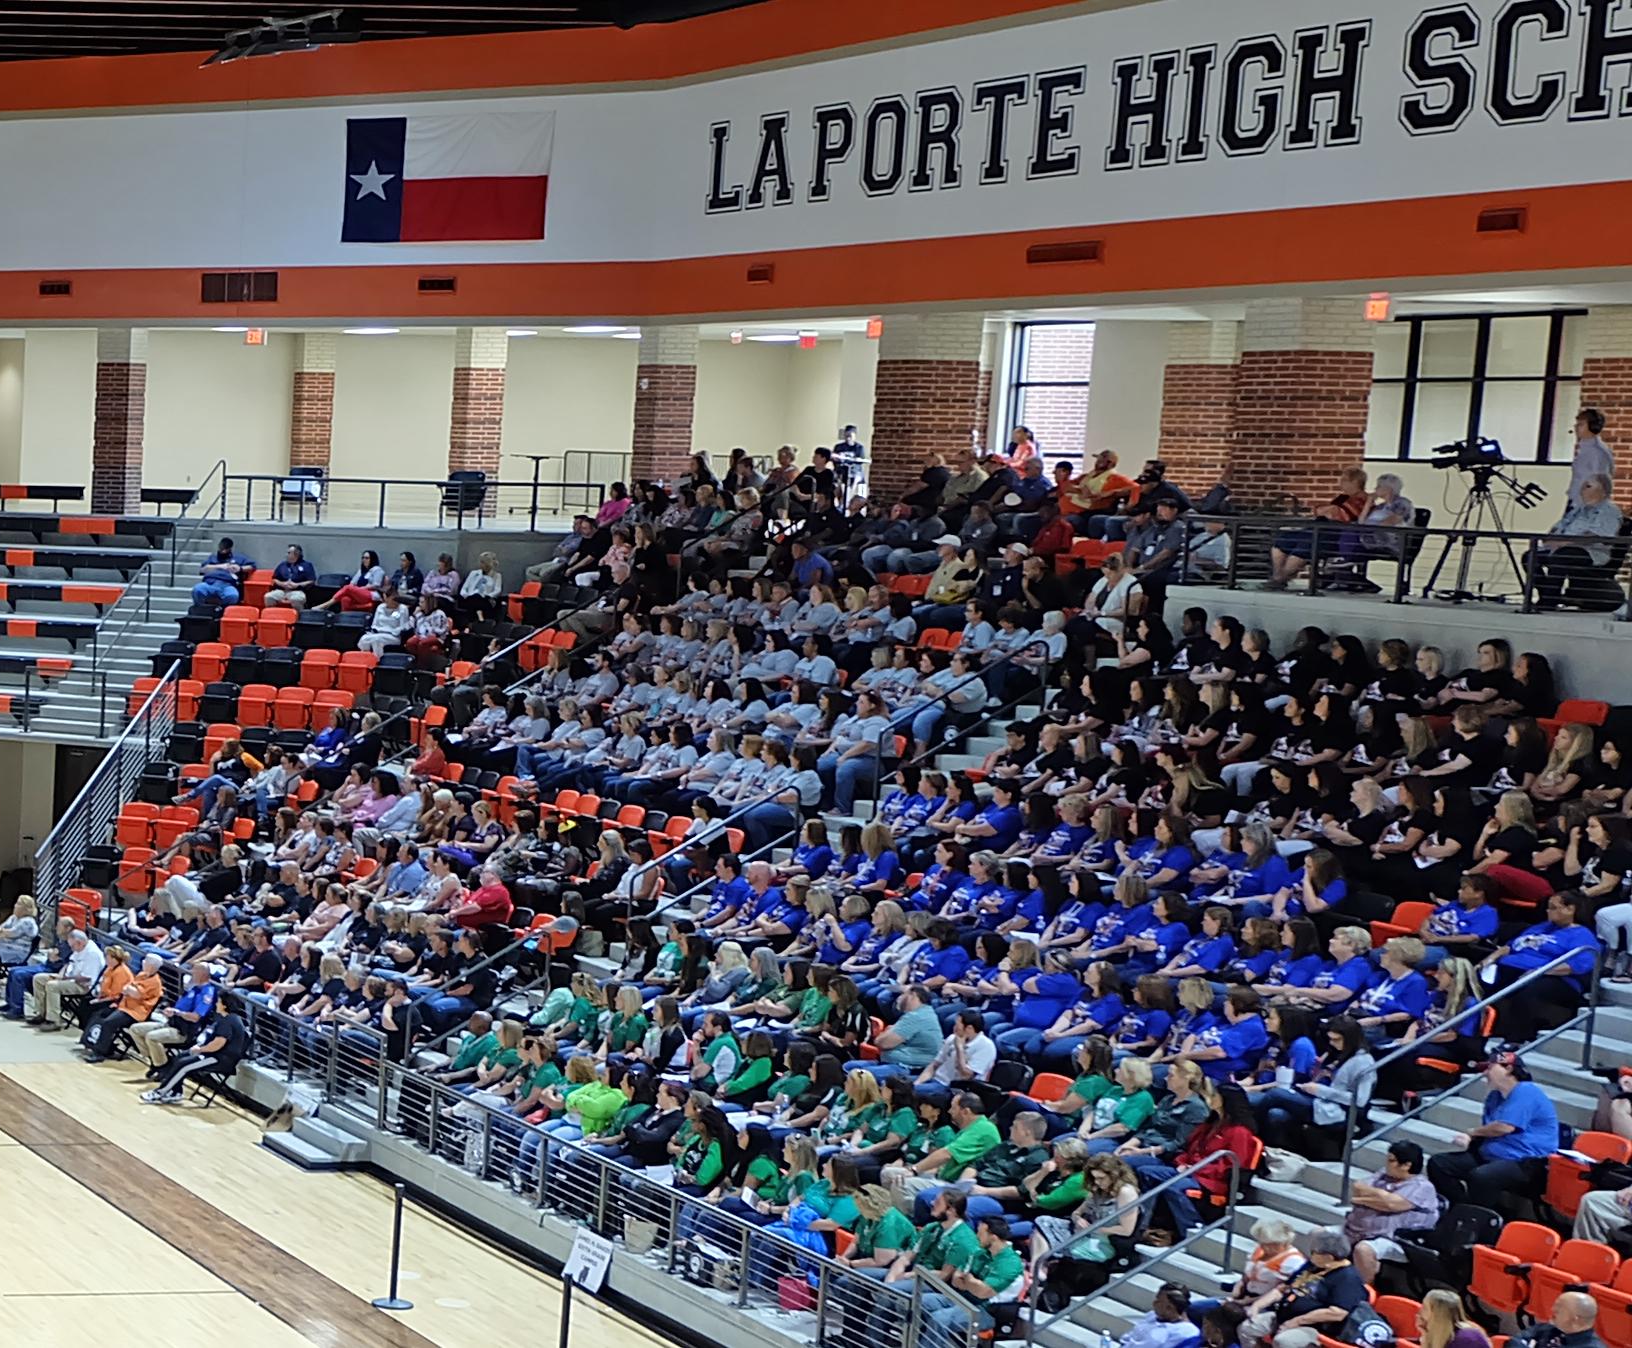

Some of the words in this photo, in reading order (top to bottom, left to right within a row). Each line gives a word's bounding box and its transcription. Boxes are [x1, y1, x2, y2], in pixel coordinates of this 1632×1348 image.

[705, 111, 794, 215] LA
[808, 64, 1088, 202] PORTE
[1104, 18, 1372, 172] HIGH
